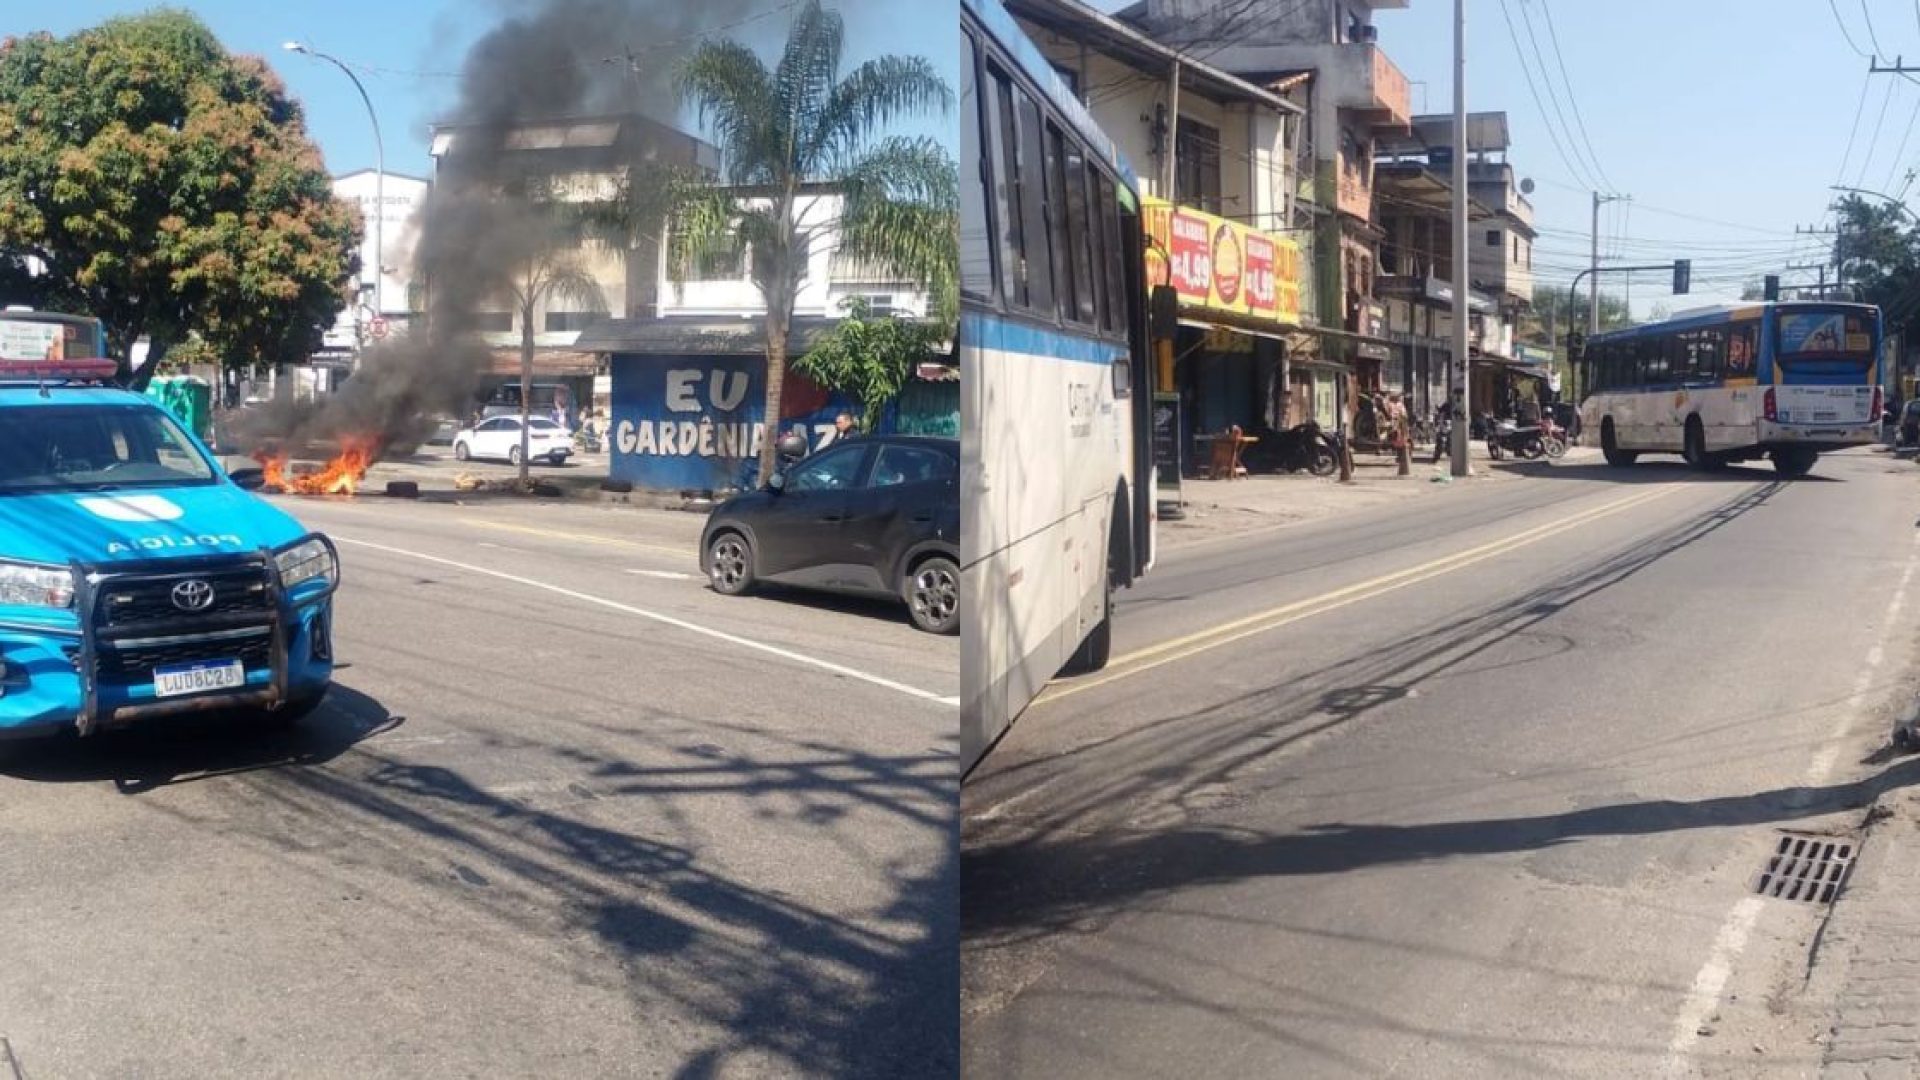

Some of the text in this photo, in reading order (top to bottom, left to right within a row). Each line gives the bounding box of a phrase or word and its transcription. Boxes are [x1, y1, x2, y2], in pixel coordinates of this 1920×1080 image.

[666, 369, 749, 412] EU
[617, 416, 837, 457] GARDÊNIA AZ
